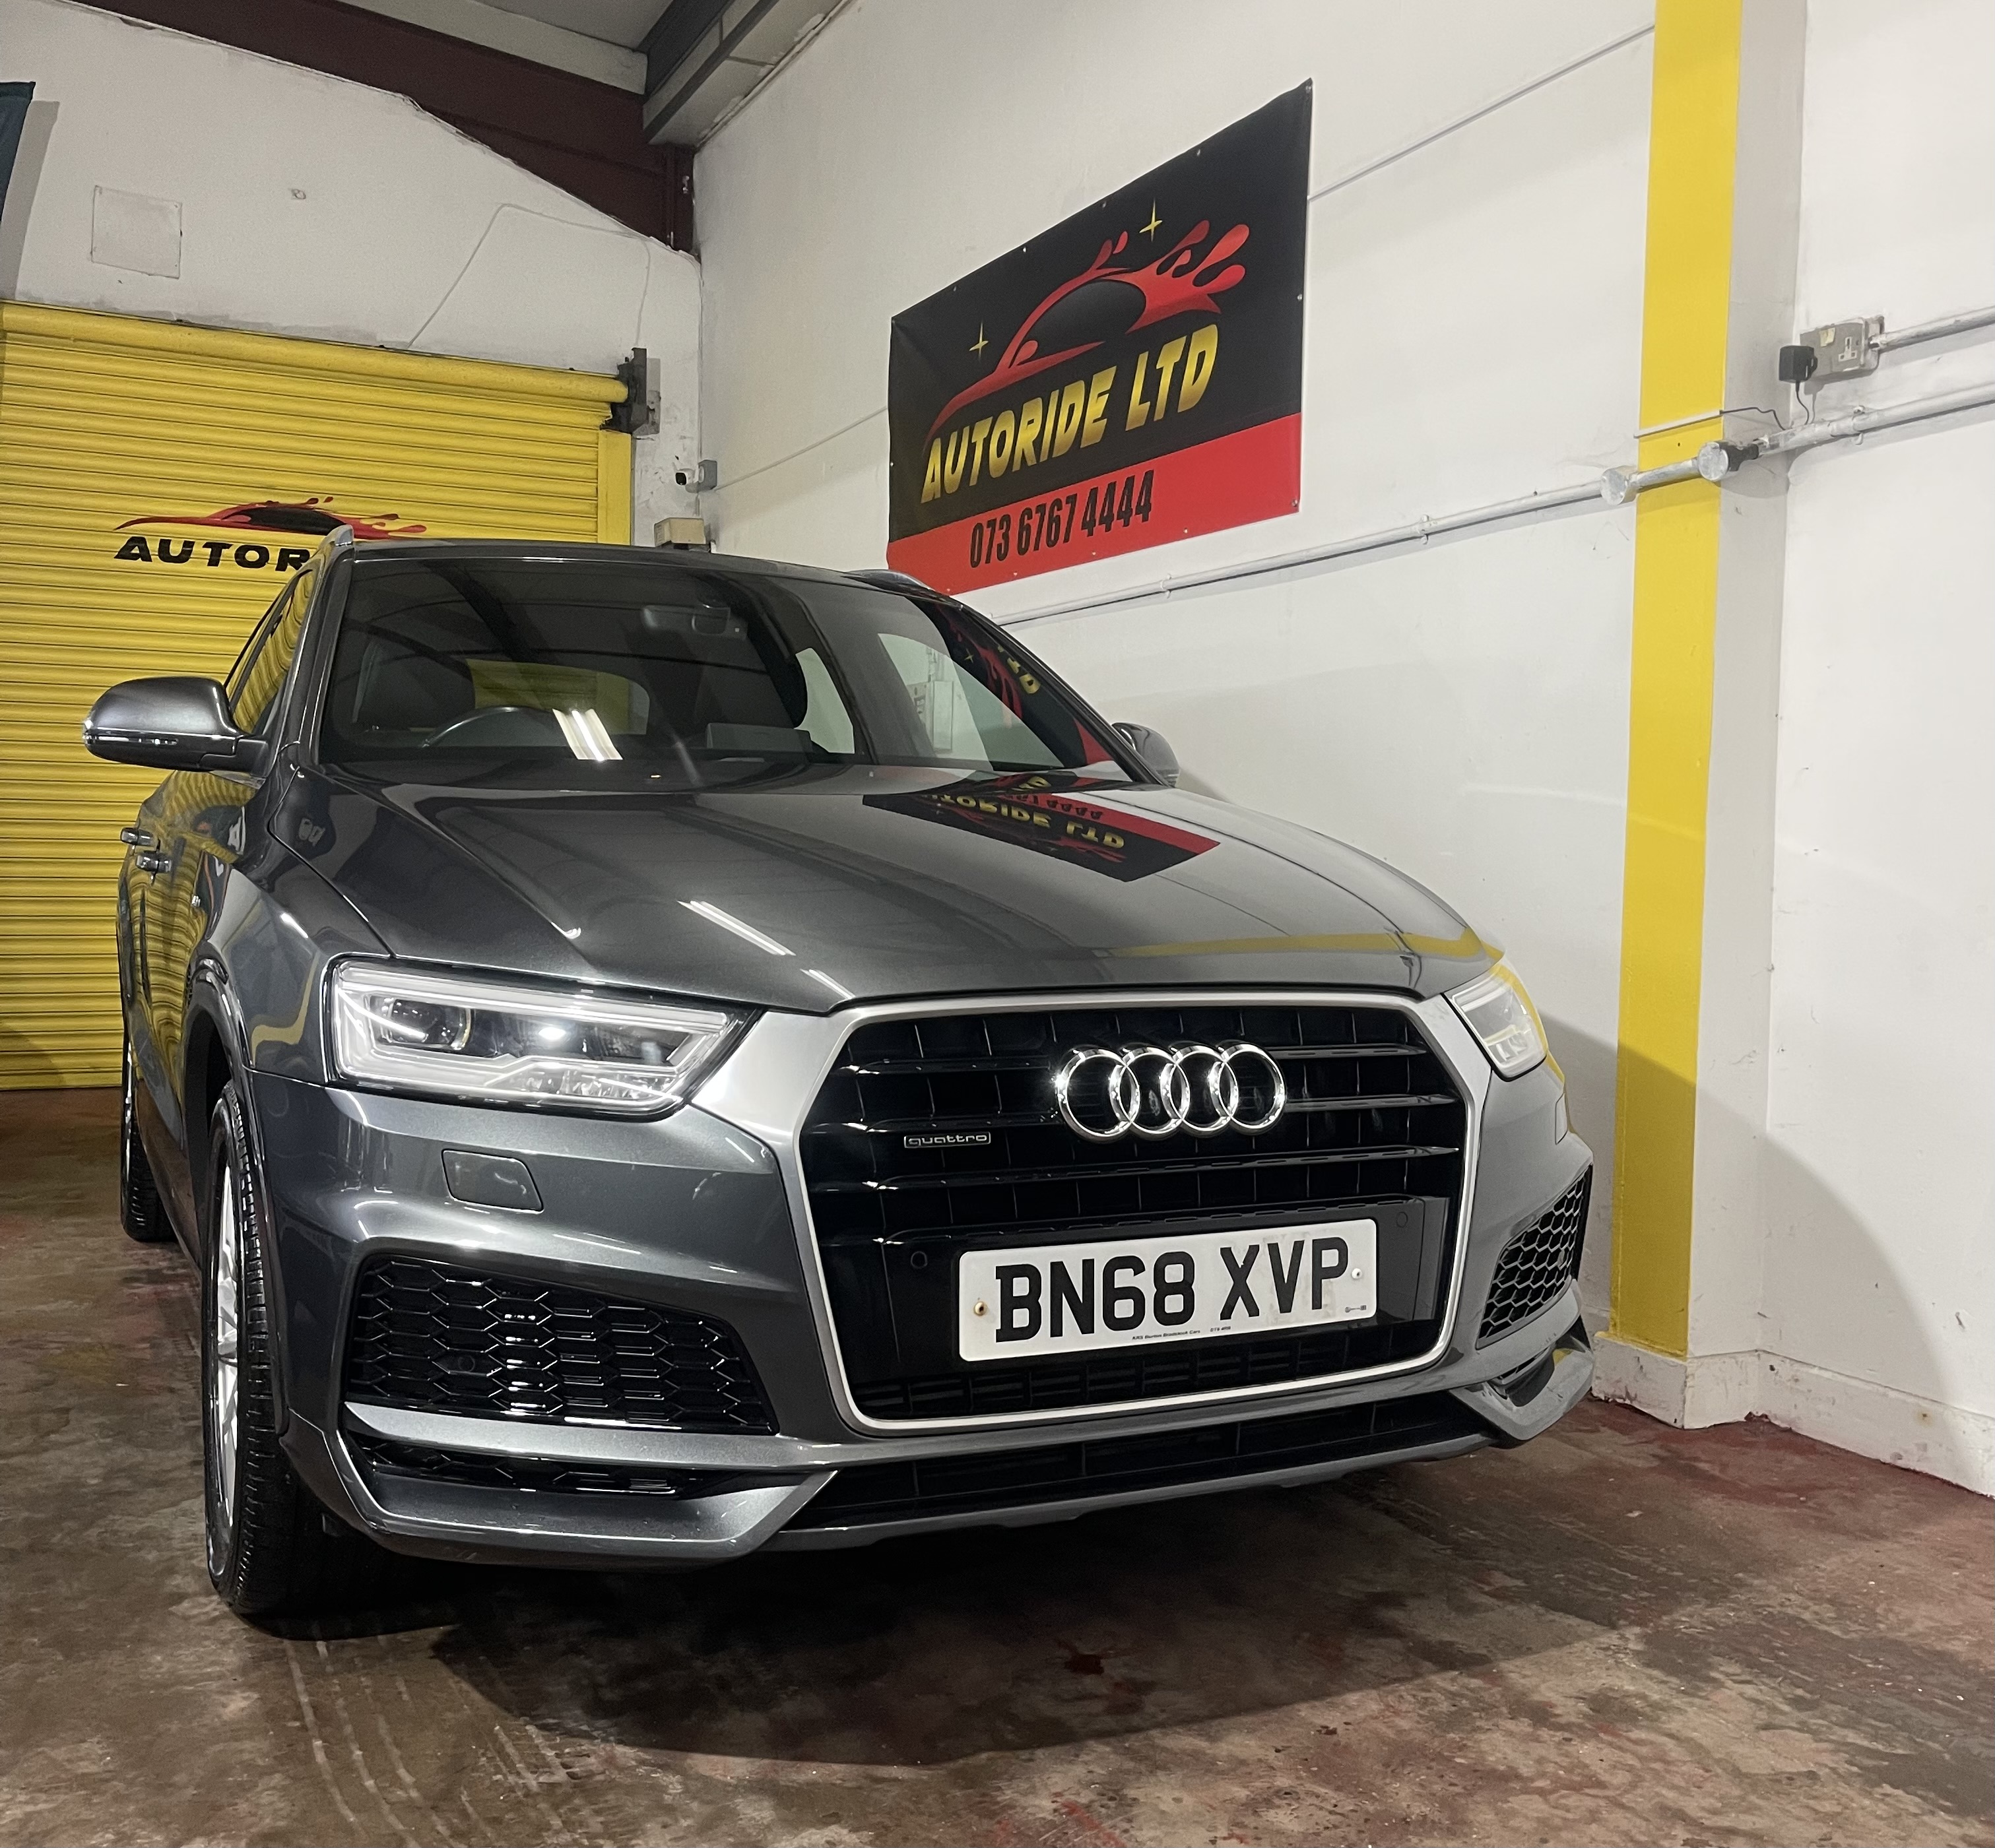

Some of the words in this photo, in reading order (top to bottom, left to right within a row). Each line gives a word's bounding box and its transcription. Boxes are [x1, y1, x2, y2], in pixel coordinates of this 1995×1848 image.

[921, 366, 1116, 503] AUTORIDE
[1125, 324, 1218, 431] LTD
[969, 513, 1010, 568] 073
[1016, 494, 1078, 557] 6767
[1080, 470, 1154, 537] 4444
[908, 1134, 987, 1146] quattro
[995, 1252, 1195, 1343] BN68
[1220, 1236, 1348, 1320] XVP
